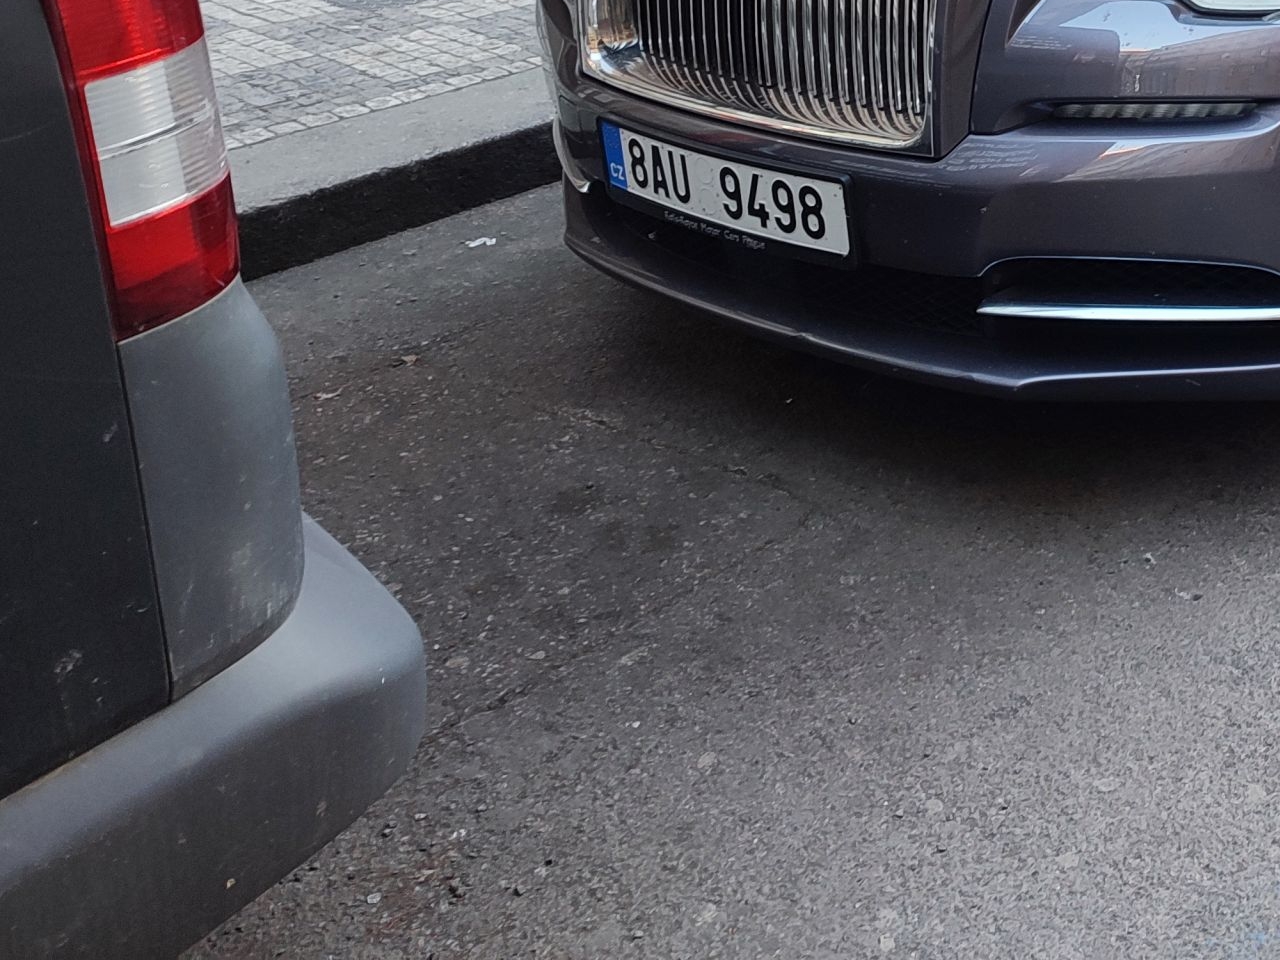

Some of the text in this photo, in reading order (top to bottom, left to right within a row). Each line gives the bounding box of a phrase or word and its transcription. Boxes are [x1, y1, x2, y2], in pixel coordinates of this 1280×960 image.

[609, 162, 626, 181] CZ
[628, 137, 827, 240] 8AU 9498
